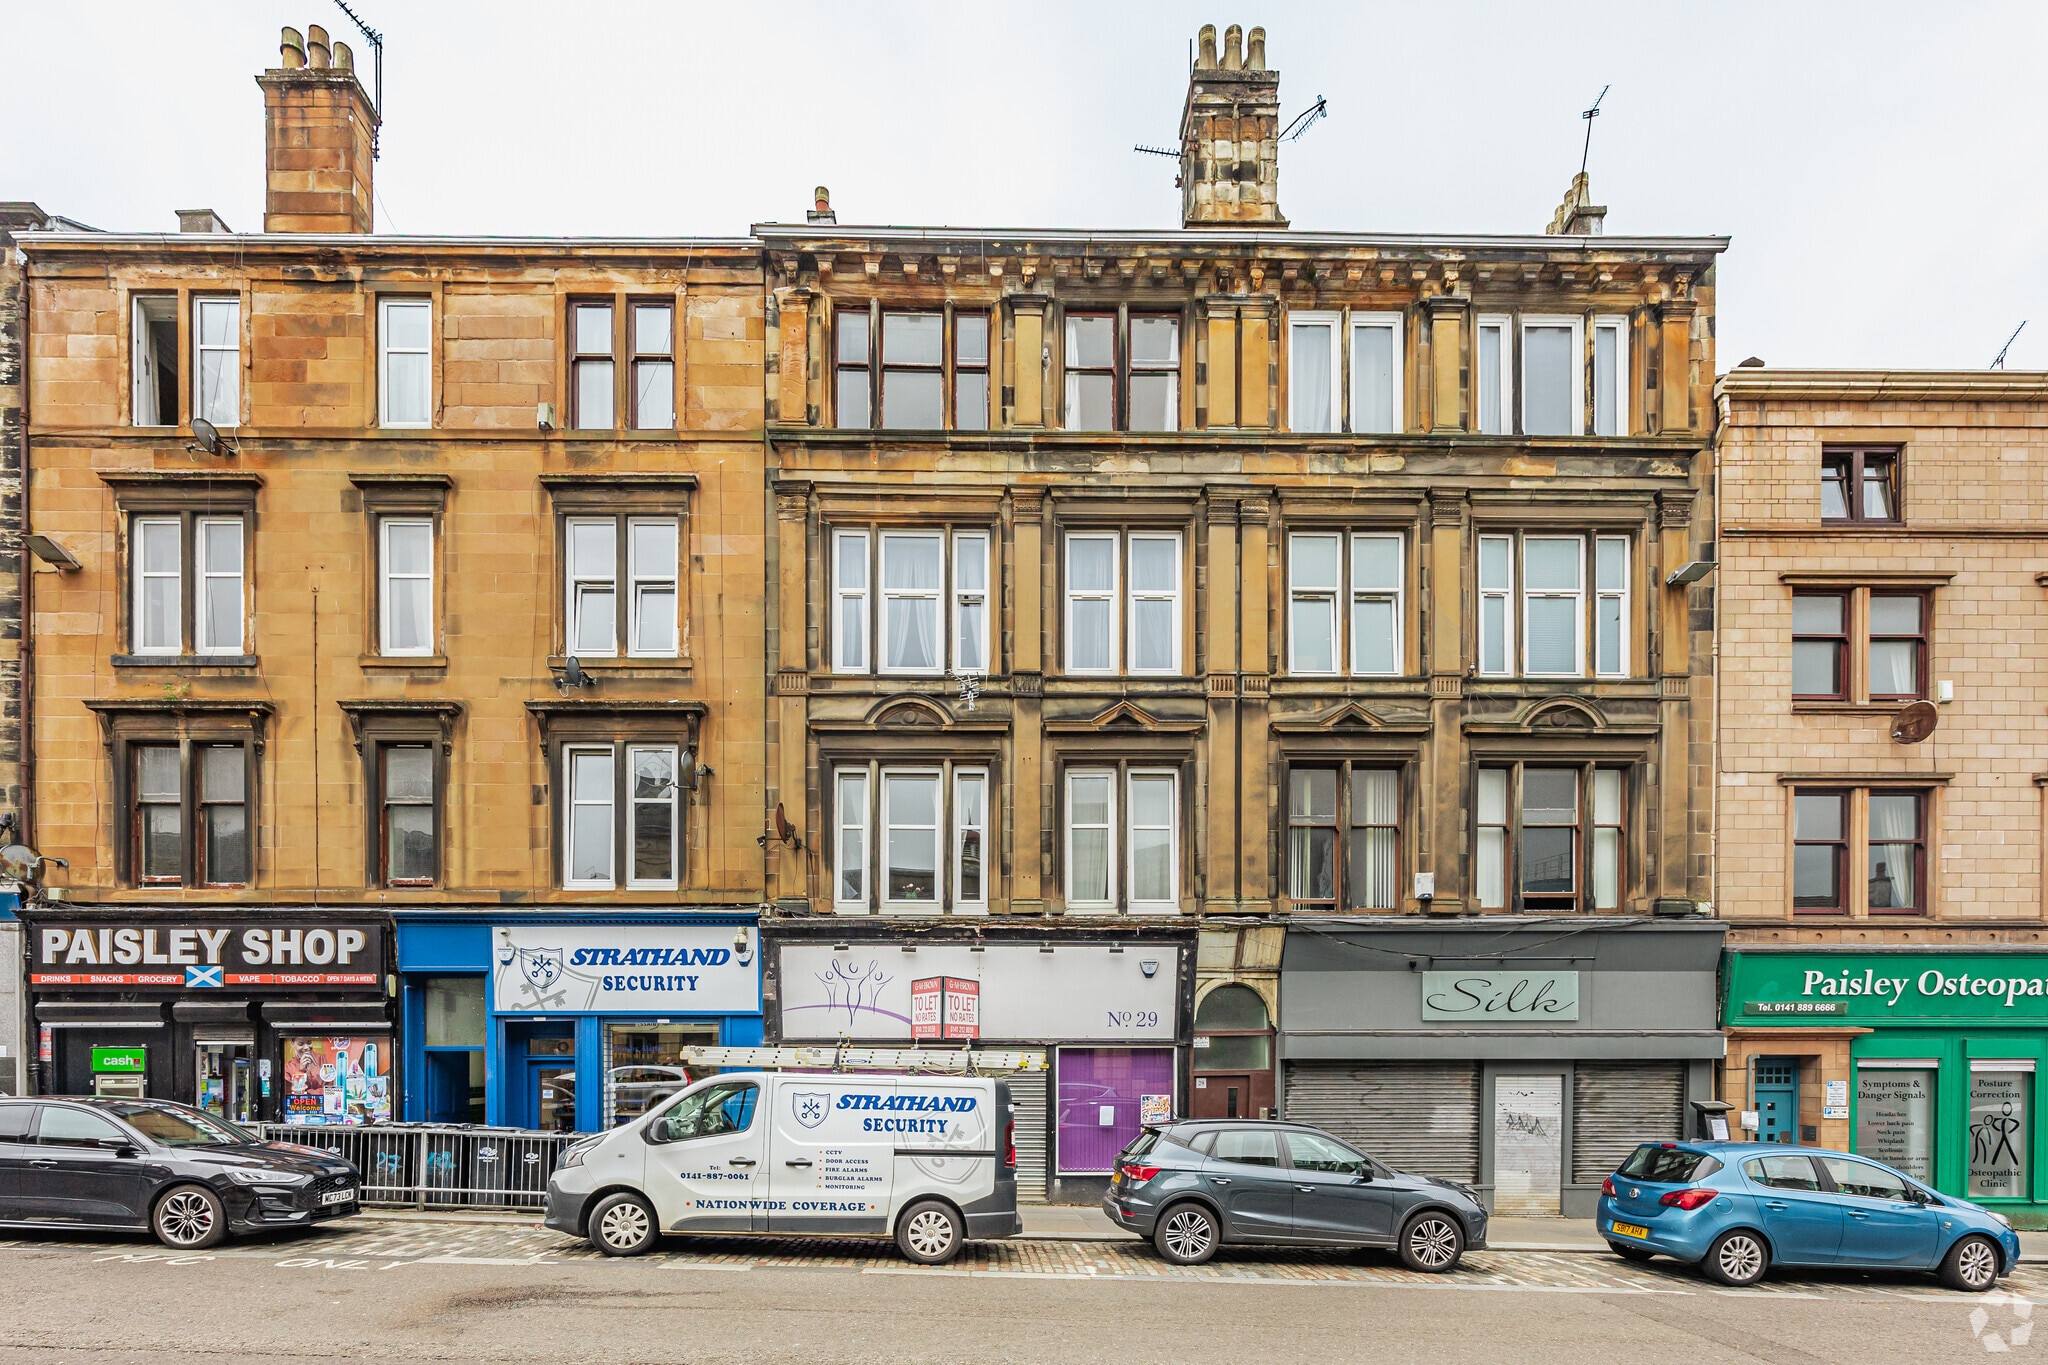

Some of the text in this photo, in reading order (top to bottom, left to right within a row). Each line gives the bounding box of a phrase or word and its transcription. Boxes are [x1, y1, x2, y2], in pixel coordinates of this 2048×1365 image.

[42, 929, 366, 965] PAISLEY SHOP
[570, 948, 731, 966] STRATHAND
[40, 975, 71, 983] DRINKS
[90, 975, 124, 983] SNACKS
[280, 975, 320, 983] TOBACCO
[603, 975, 699, 991] SECURITY
[1802, 969, 1910, 1006] Paisley
[1426, 978, 1575, 1013] Silk
[914, 995, 938, 1011] TO LET
[948, 995, 976, 1012] TO LET
[1758, 1003, 1836, 1011] Tel. 0141 889 6666
[915, 1012, 937, 1022] NO RATES
[950, 1012, 975, 1023] NO RATES
[1136, 1011, 1158, 1027] 29
[103, 1055, 134, 1066] cash
[1862, 1079, 1920, 1090] Symptoms &
[1978, 1079, 2013, 1087] Posture
[1858, 1091, 1892, 1102] Danger
[1893, 1091, 1926, 1102] Signals
[1970, 1090, 2020, 1099] Correction
[835, 1094, 977, 1113] STRATHAND
[863, 1118, 949, 1134] SECURITY
[680, 1172, 750, 1181] 0141-887-0061
[1968, 1168, 2022, 1179] Osteopathic
[1980, 1180, 2008, 1188] Clinic
[696, 1200, 866, 1212] NATIONWIDE COVERAGE
[1631, 1226, 1643, 1236] AHA
[274, 1258, 416, 1270] ONLY
